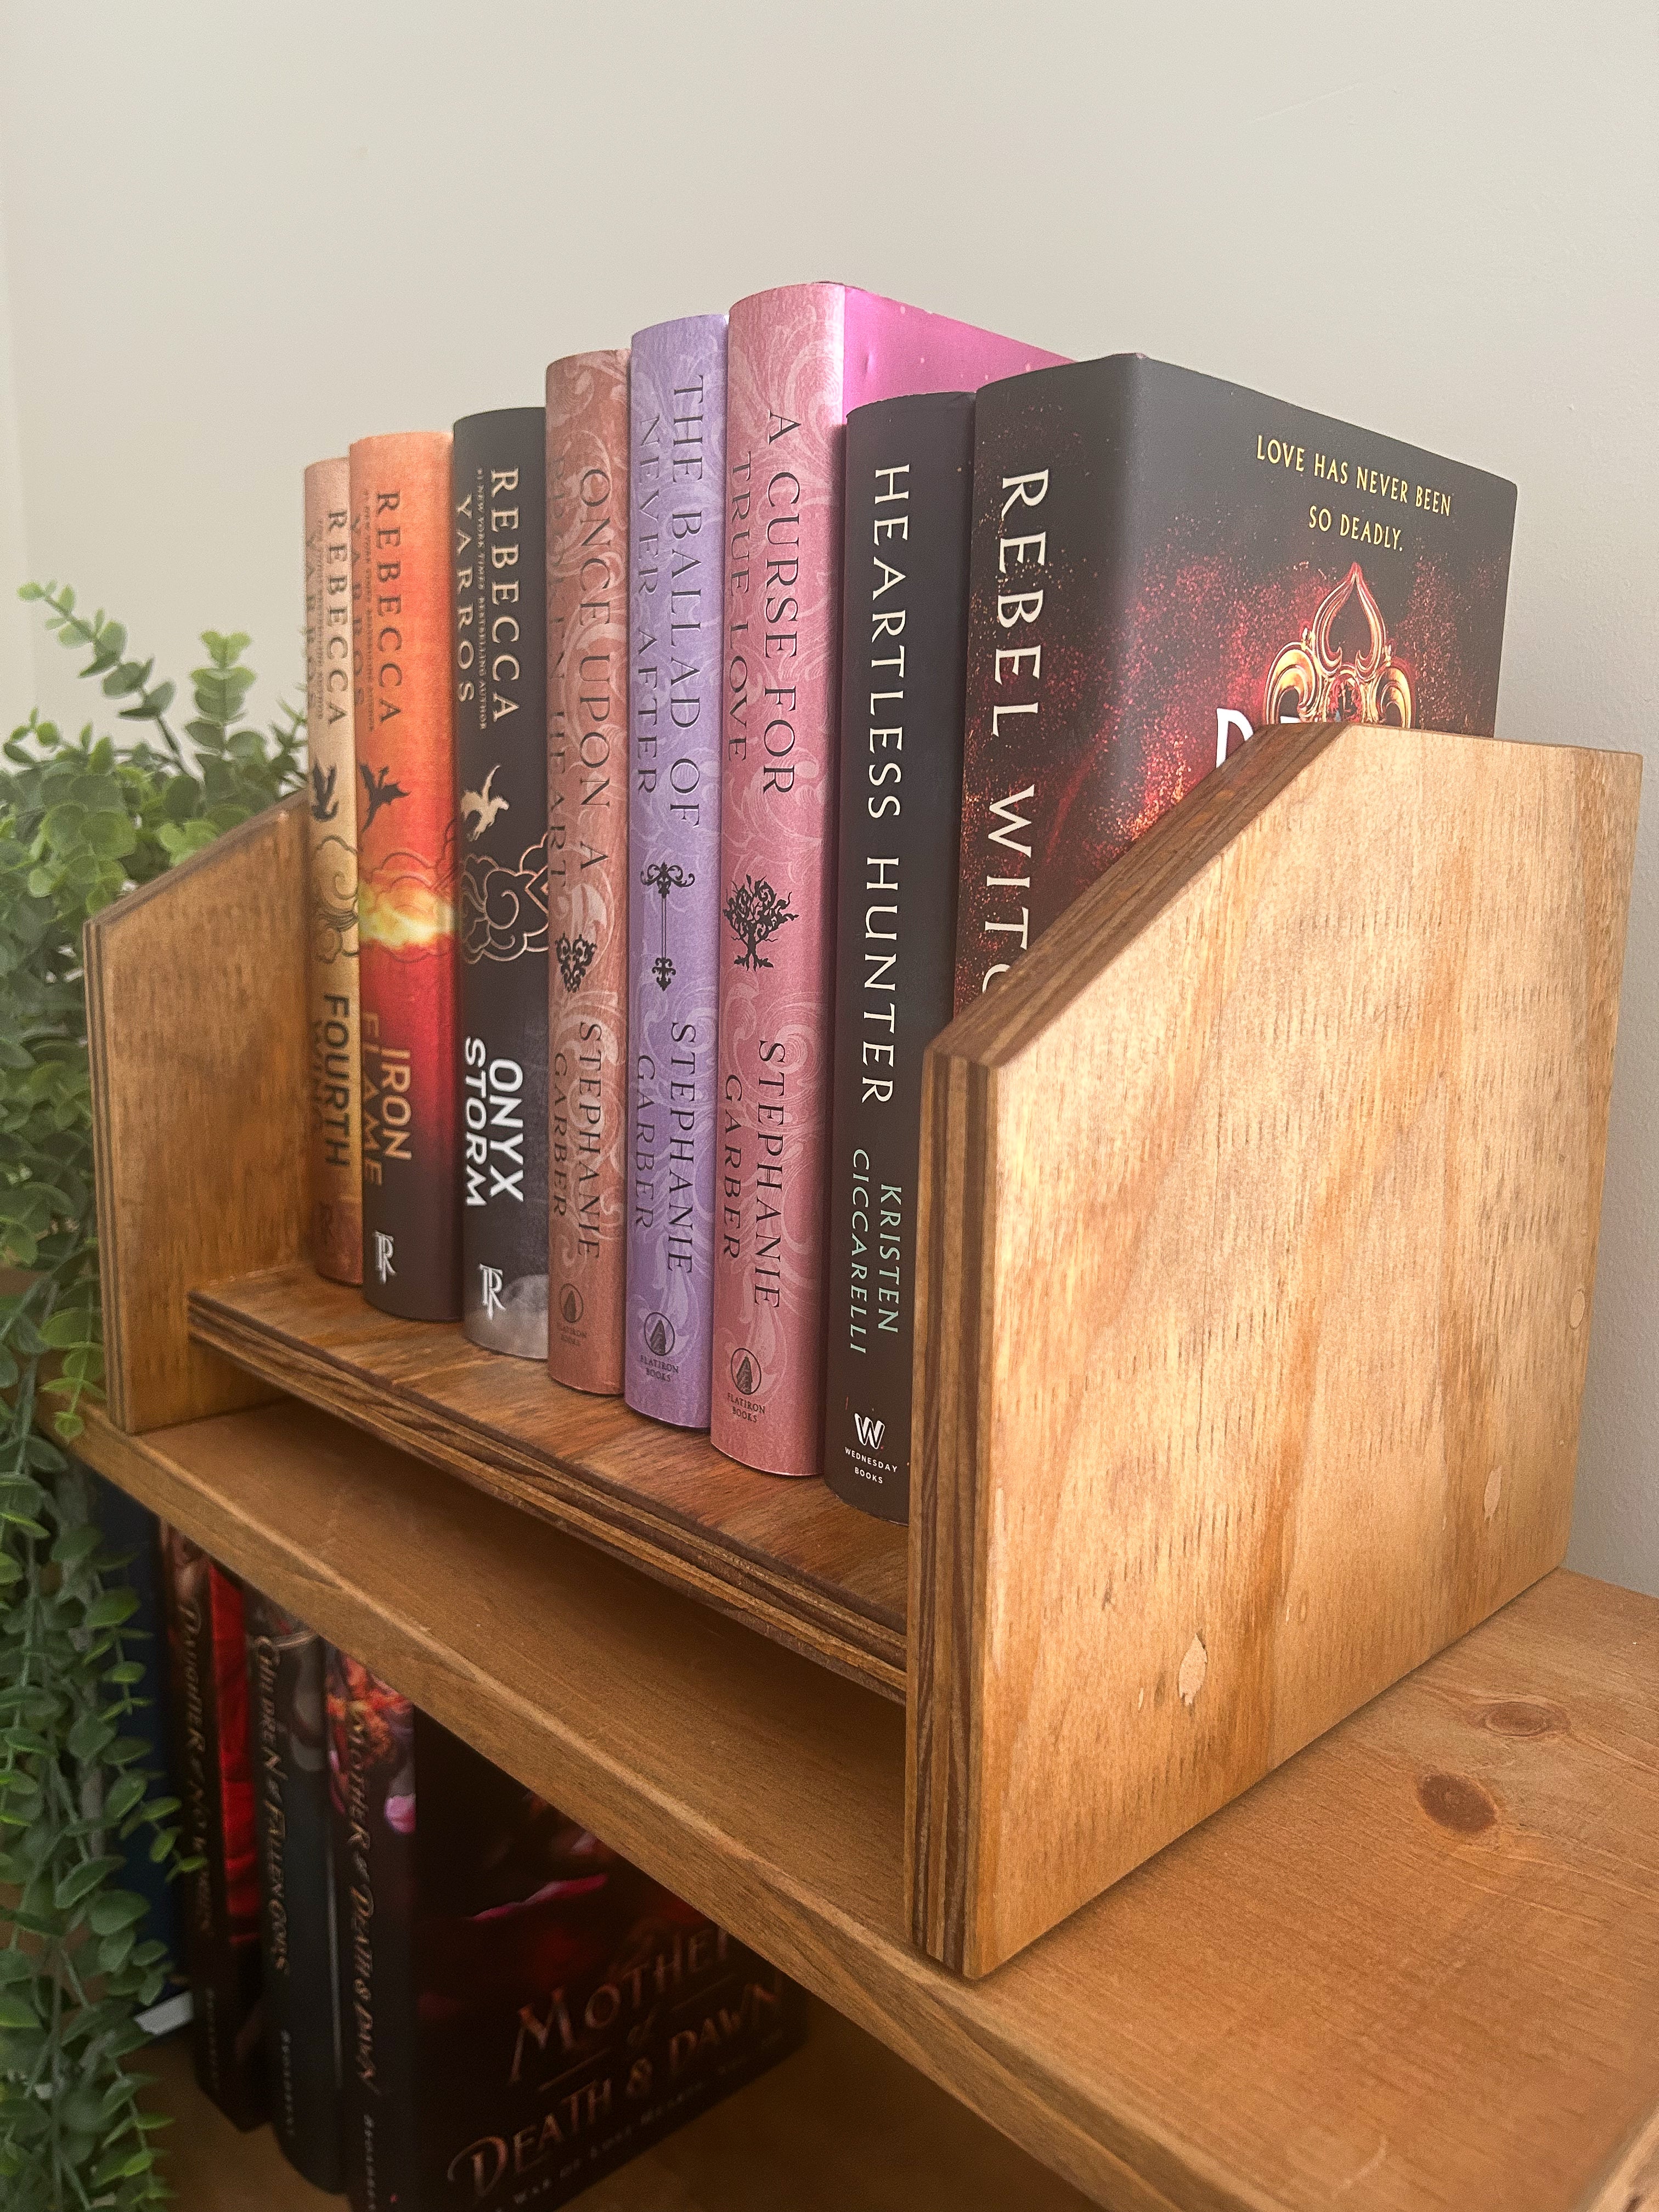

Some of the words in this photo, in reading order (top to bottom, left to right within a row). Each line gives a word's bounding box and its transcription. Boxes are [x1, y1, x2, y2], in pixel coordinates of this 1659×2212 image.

[638, 415, 660, 594] NEVER
[673, 374, 703, 482] THE
[768, 409, 802, 445] A
[1257, 435, 1305, 472] LOVE
[1314, 453, 1348, 484] HAS
[1357, 466, 1408, 504] NEVER
[1415, 486, 1451, 516] BEEN
[456, 494, 474, 702] YARROS
[492, 467, 520, 722] REBECCA
[580, 469, 611, 626] ONCE
[730, 451, 751, 596] TRUE
[765, 471, 800, 658] CURSE
[992, 467, 1049, 737] REBEL
[1309, 505, 1331, 532] SO
[1340, 514, 1403, 551] DEADLY.
[329, 511, 348, 725] REBECCA
[377, 491, 403, 723] REBECCA
[670, 511, 702, 729] BALLAD
[867, 464, 910, 817] HEARTLESS
[579, 655, 610, 807] UPON
[637, 628, 658, 794] AFTER
[728, 622, 748, 762] LOVE
[763, 685, 796, 794] FOR
[580, 842, 608, 870] A
[669, 758, 700, 828] OF
[861, 856, 900, 1104] HUNTER
[324, 994, 349, 1166] FOURTH
[362, 1013, 383, 1185] FLAME
[382, 1048, 411, 1160] IRON
[465, 1036, 487, 1206] STORM
[490, 1059, 523, 1201] ONYX
[554, 1053, 567, 1216] GARBER
[579, 1022, 602, 1258] STEPHANIE
[636, 1054, 656, 1229] GARBER
[668, 1021, 697, 1273] STEPHANIE
[723, 1074, 743, 1259] GARBER
[754, 1039, 786, 1308] STEPHANIE
[850, 1149, 870, 1353] CICCARELLI
[878, 1184, 902, 1333] KRISTEN
[640, 1355, 679, 1374] FLATIRON
[646, 1368, 671, 1383] BOOKS
[727, 1392, 766, 1414] FLATIRON
[732, 1406, 758, 1423] BOOKS
[844, 1446, 898, 1473] WEDNESDAY
[854, 1467, 883, 1485] BOOKS
[448, 2078, 611, 2197] DEATH
